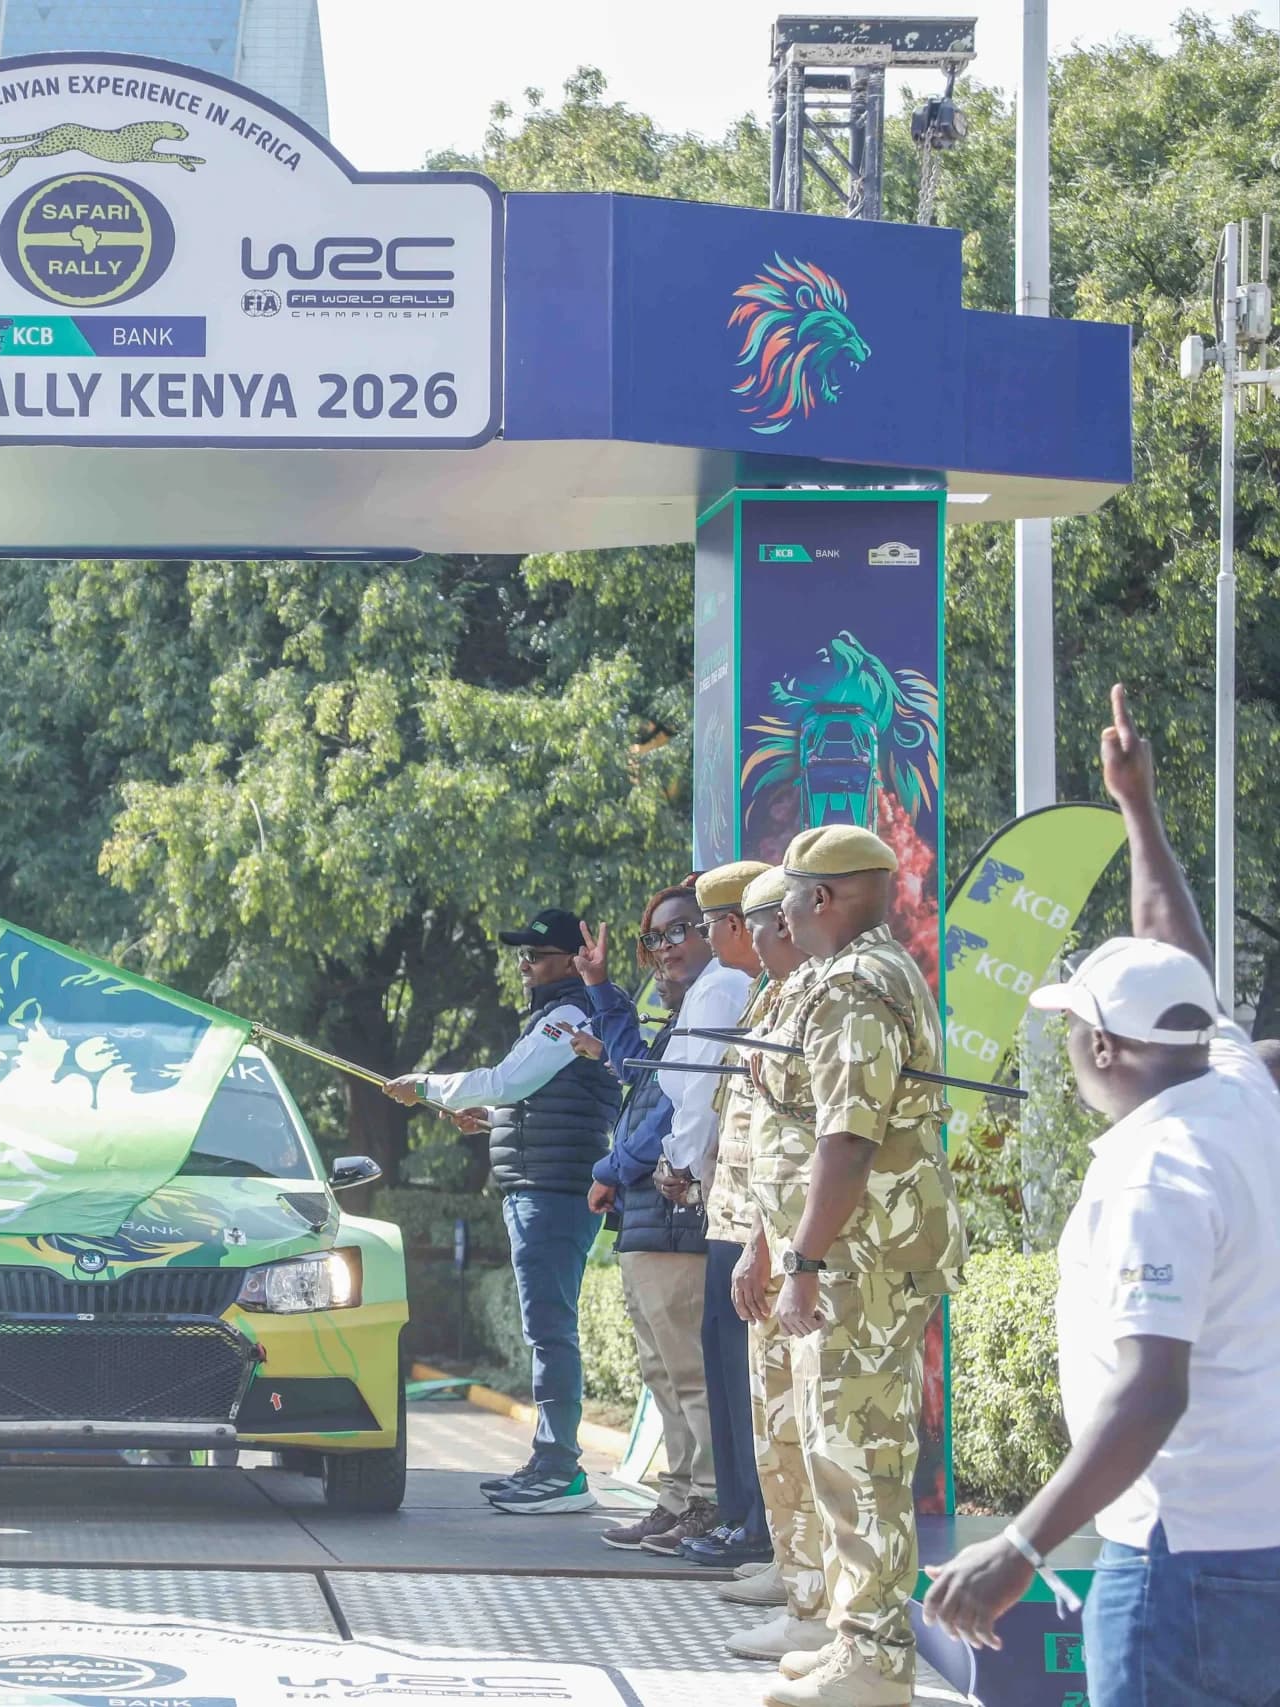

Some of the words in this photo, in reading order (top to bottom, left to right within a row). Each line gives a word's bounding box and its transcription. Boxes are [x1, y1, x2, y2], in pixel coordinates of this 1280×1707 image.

[68, 75, 202, 115] EXPERIENCE
[205, 102, 230, 126] IN
[230, 116, 301, 171] AFRICA
[41, 204, 130, 220] SAFARI
[241, 236, 455, 281] WRC
[48, 260, 123, 275] RALLY
[291, 294, 317, 304] FIA
[321, 294, 384, 304] WORLD
[389, 295, 450, 305] RALLY
[291, 311, 450, 319] CHAMPIONSHIP
[12, 326, 54, 346] KCB
[113, 327, 174, 346] BANK
[120, 372, 298, 418] KENYA
[317, 371, 459, 419] 2026
[815, 549, 840, 558] BANK
[1011, 885, 1070, 930] KCB
[975, 953, 1034, 995] KCB
[946, 1018, 1000, 1064] KCB
[121, 1222, 185, 1237] BANK
[7, 1659, 125, 1669] SAFARI
[17, 1673, 118, 1684] RALLY
[108, 1699, 192, 1707] BANK
